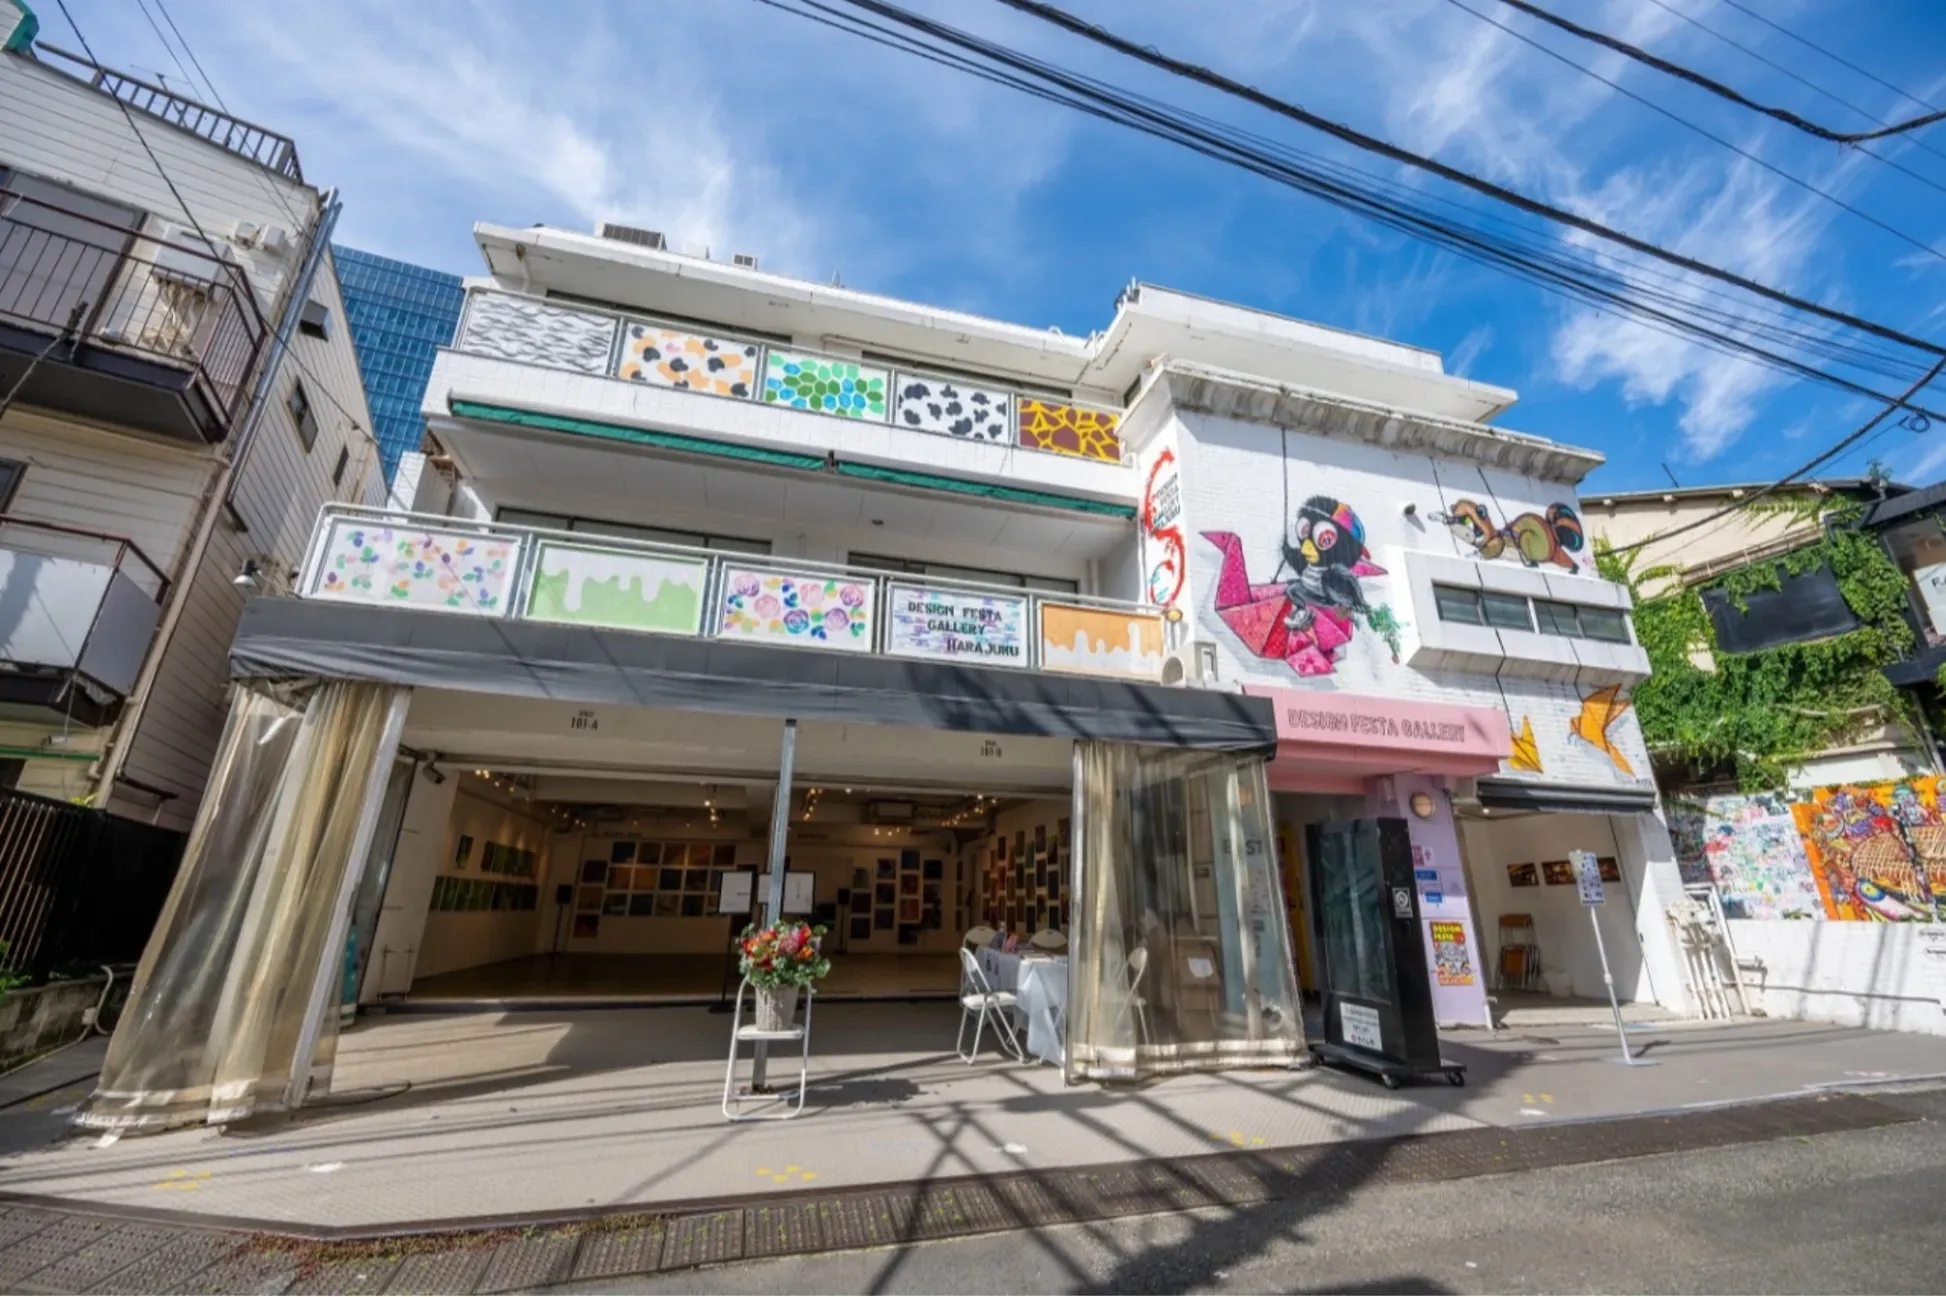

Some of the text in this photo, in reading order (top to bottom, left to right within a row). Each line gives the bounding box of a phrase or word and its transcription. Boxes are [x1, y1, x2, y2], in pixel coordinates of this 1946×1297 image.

[908, 601, 1002, 621] DESIGN FESTA
[927, 620, 985, 635] GALLERY
[946, 638, 1020, 656] HARAJUKU
[1287, 708, 1464, 743] DESIGN FESTA GALLERY
